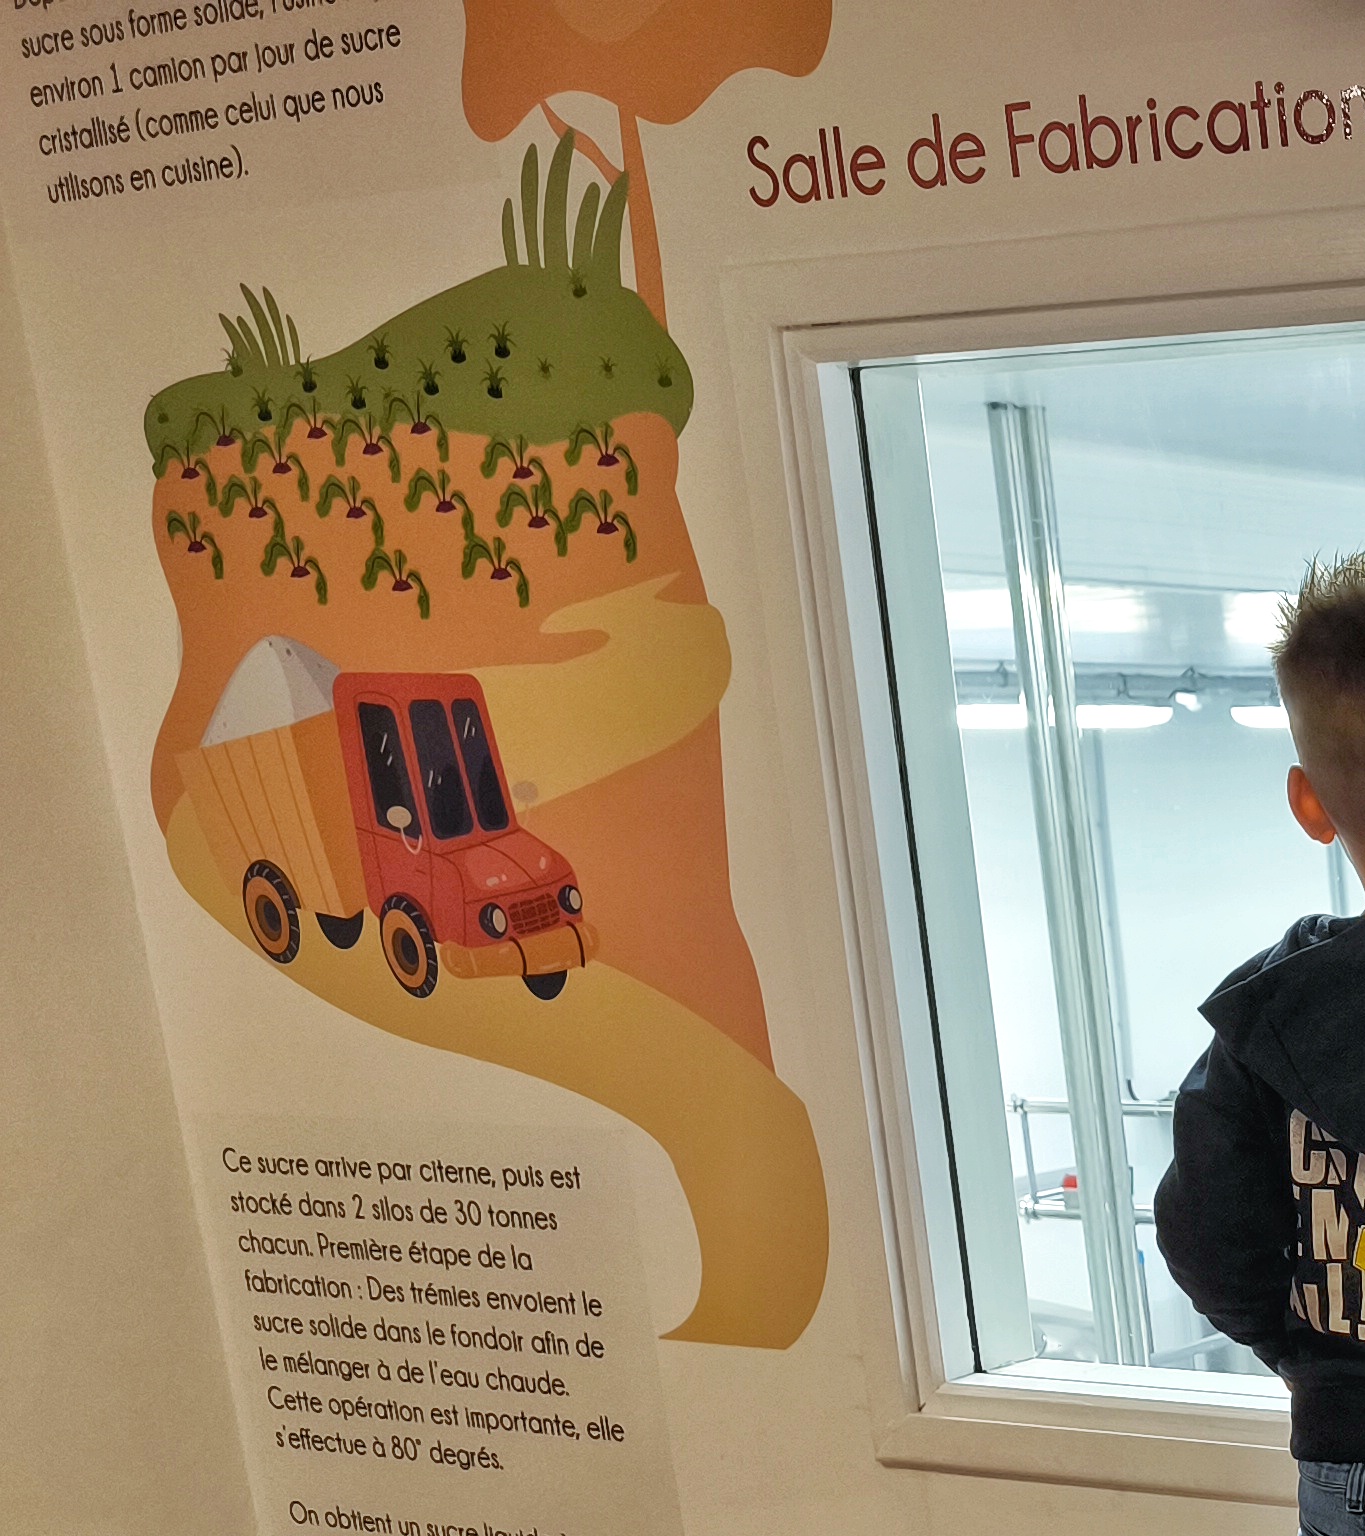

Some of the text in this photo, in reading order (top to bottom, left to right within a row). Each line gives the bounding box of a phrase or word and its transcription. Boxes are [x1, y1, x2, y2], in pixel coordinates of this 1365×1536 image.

[21, 29, 75, 59] sucre
[80, 20, 125, 48] sous
[127, 8, 188, 39] forme
[29, 23, 401, 108] environ 1 camion par jour de sucre
[38, 81, 384, 156] cristallisé (comme celui que nous
[46, 144, 249, 204] utilisons en cuisine).
[746, 125, 887, 209] Salle
[906, 112, 987, 190] de
[222, 1146, 581, 1192] Ce sucre arrive par citerne, puis est
[230, 1190, 558, 1231] stocké dans 2 silos de 30 tonnes
[238, 1228, 533, 1271] chacun. Première étape de la
[244, 1268, 353, 1299] fabrication
[365, 1275, 405, 1303] Des
[409, 1281, 481, 1309] trémies
[486, 1291, 576, 1315] envoient
[581, 1290, 603, 1318] le
[253, 1313, 605, 1359] sucre solide dans le fondoir afin de
[258, 1346, 570, 1397] le mélanger à de l'eau chaude.
[267, 1385, 625, 1443] Cette opération est importante, elle
[275, 1424, 367, 1456] s'effectue
[372, 1435, 387, 1458] à
[429, 1439, 504, 1471] degrés.
[289, 1500, 320, 1526] On
[324, 1505, 393, 1535] obtient
